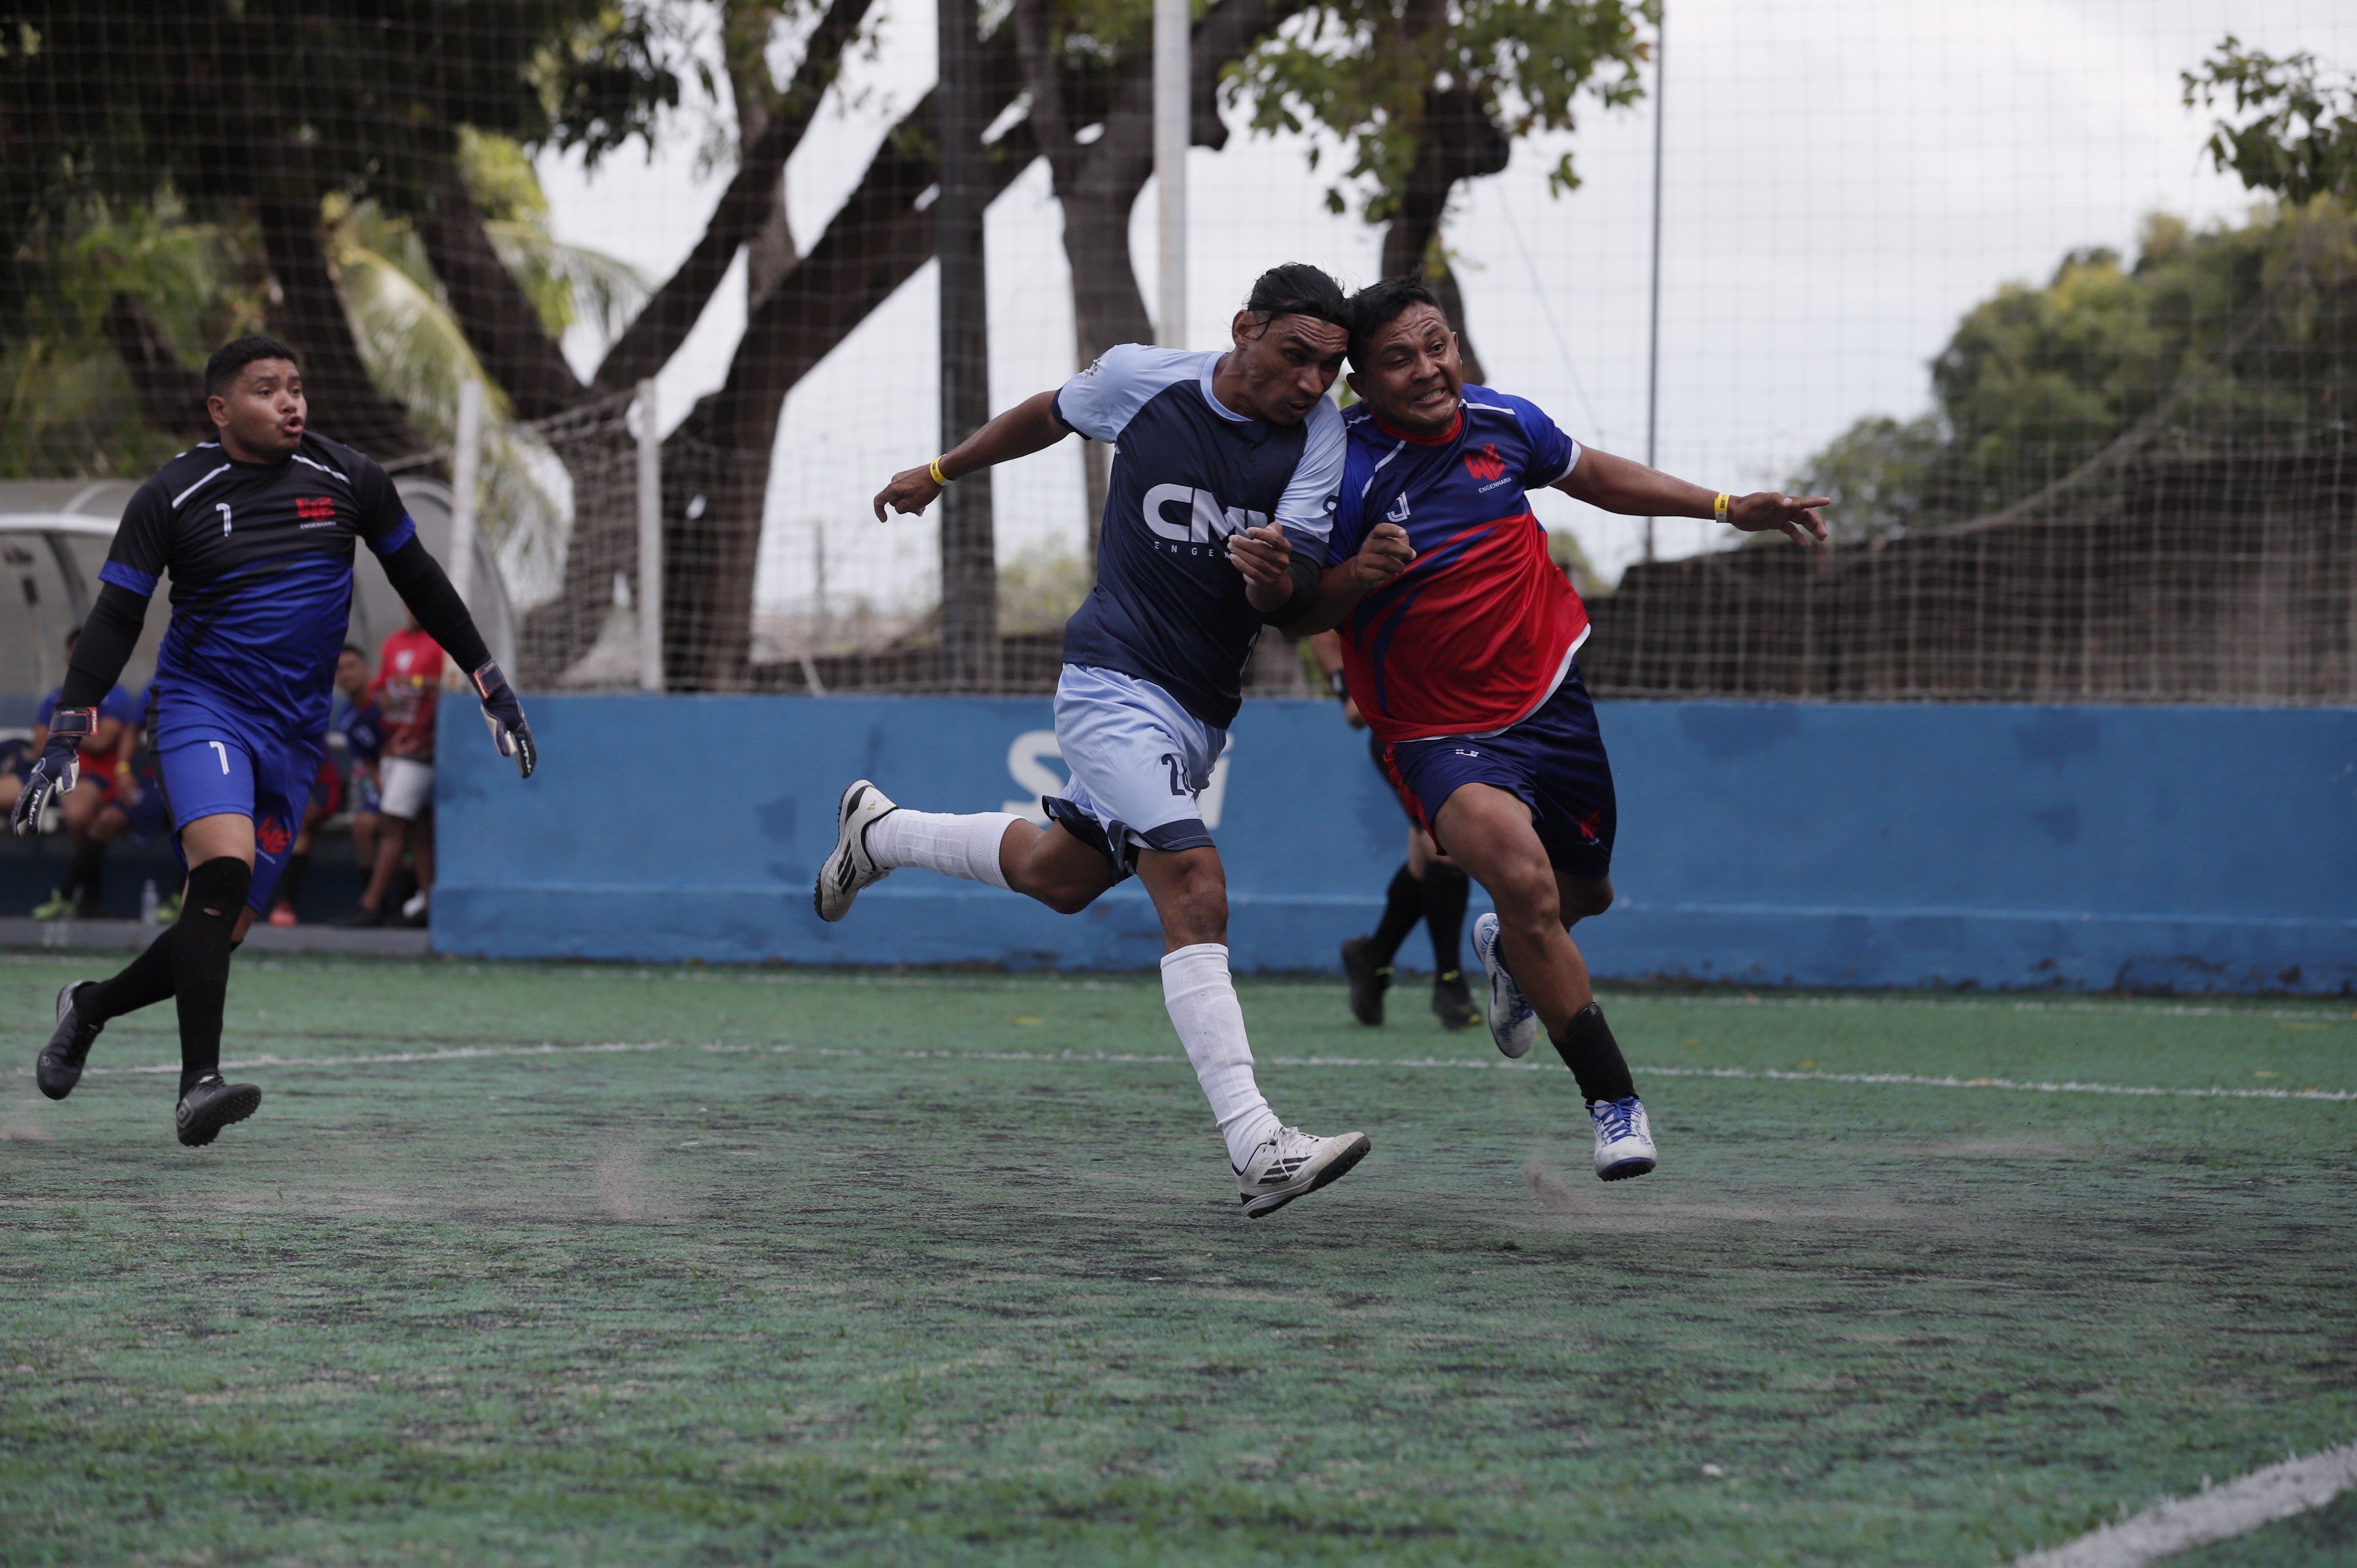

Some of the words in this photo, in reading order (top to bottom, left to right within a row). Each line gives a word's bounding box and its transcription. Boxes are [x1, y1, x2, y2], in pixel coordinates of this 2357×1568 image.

[1478, 476, 1512, 493] ENGENHARIA
[216, 502, 232, 537] 1
[209, 740, 231, 776] 1
